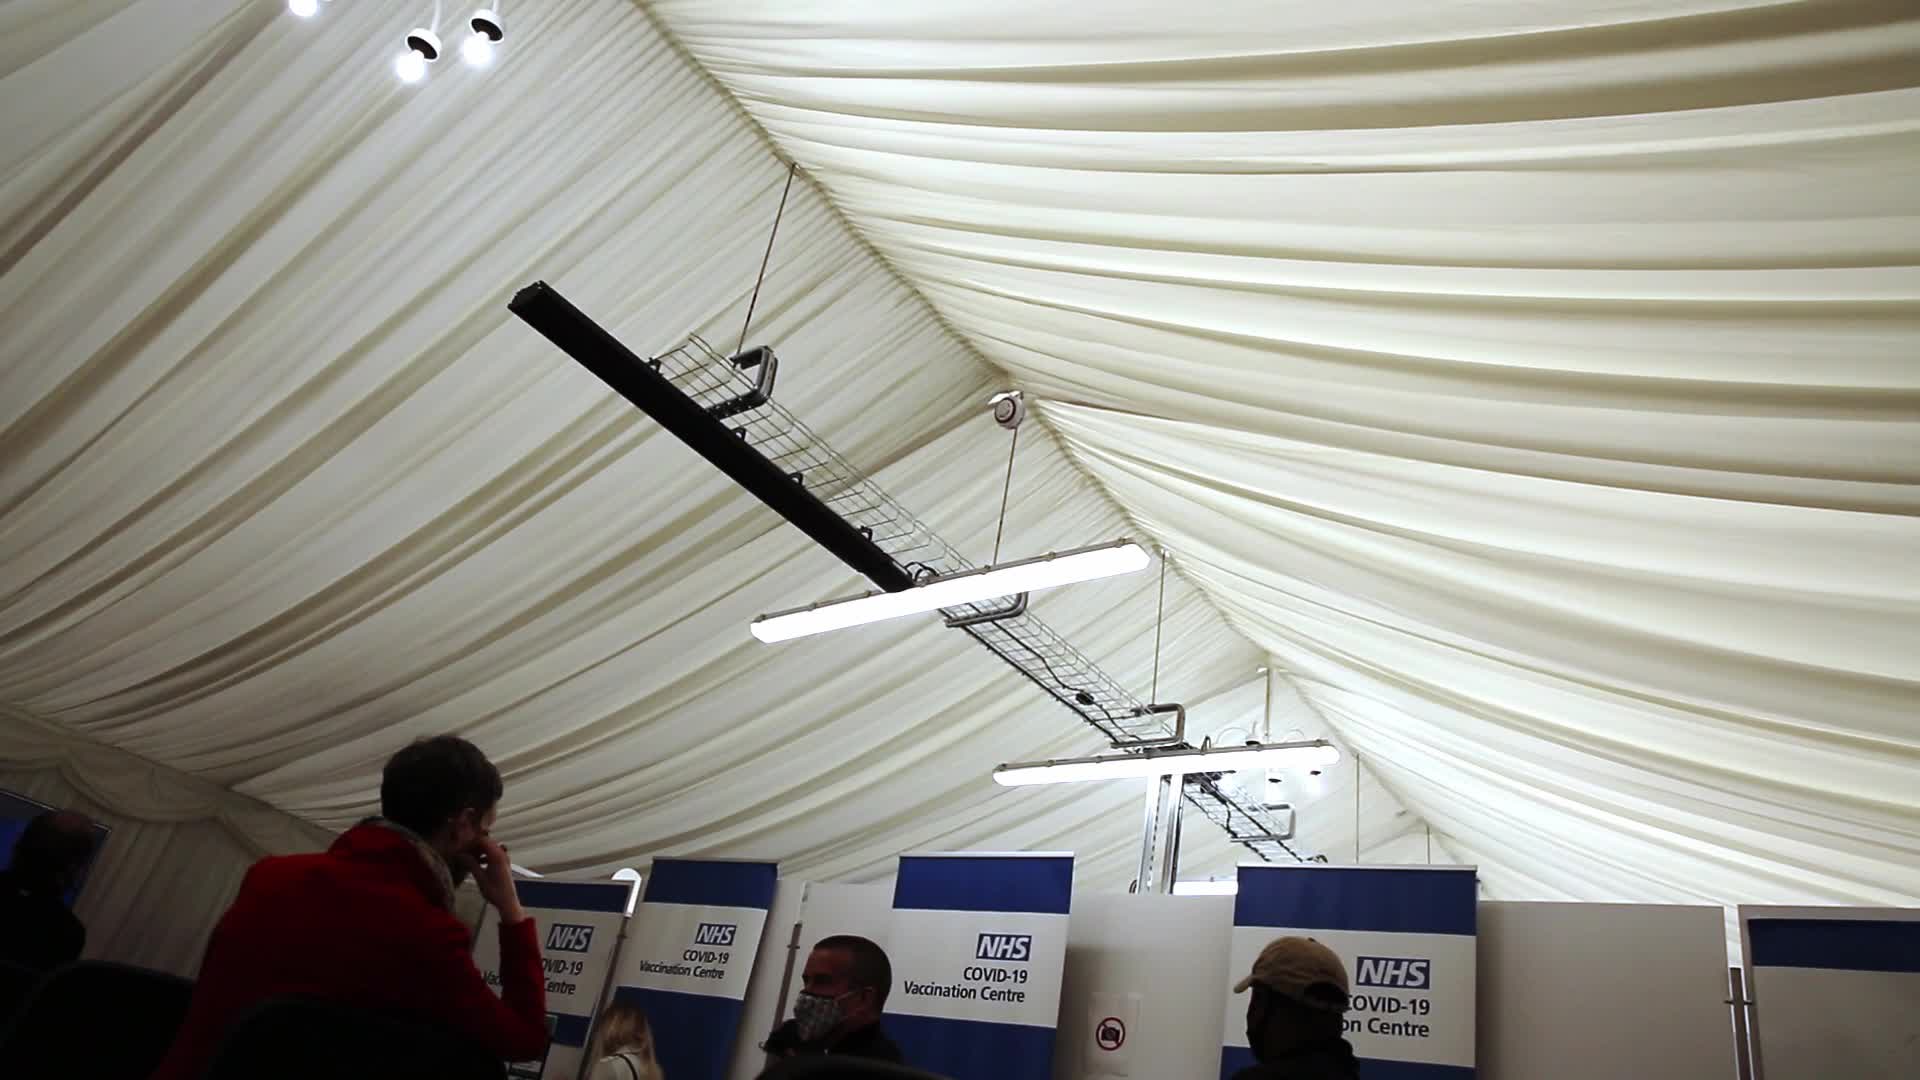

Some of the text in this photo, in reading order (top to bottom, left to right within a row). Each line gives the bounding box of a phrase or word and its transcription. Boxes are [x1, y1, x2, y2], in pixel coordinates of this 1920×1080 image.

[548, 926, 592, 951] NHS
[697, 925, 735, 944] NHS
[683, 949, 729, 964] COVID-19
[978, 935, 1029, 959] NHS
[541, 958, 583, 976] OVID-19
[640, 960, 724, 979] Vaccination Centre
[963, 966, 1028, 983] COVID-19
[1358, 959, 1427, 986] NHS
[904, 980, 1025, 1002] Vaccination Centre
[1367, 1017, 1430, 1037] Centre
